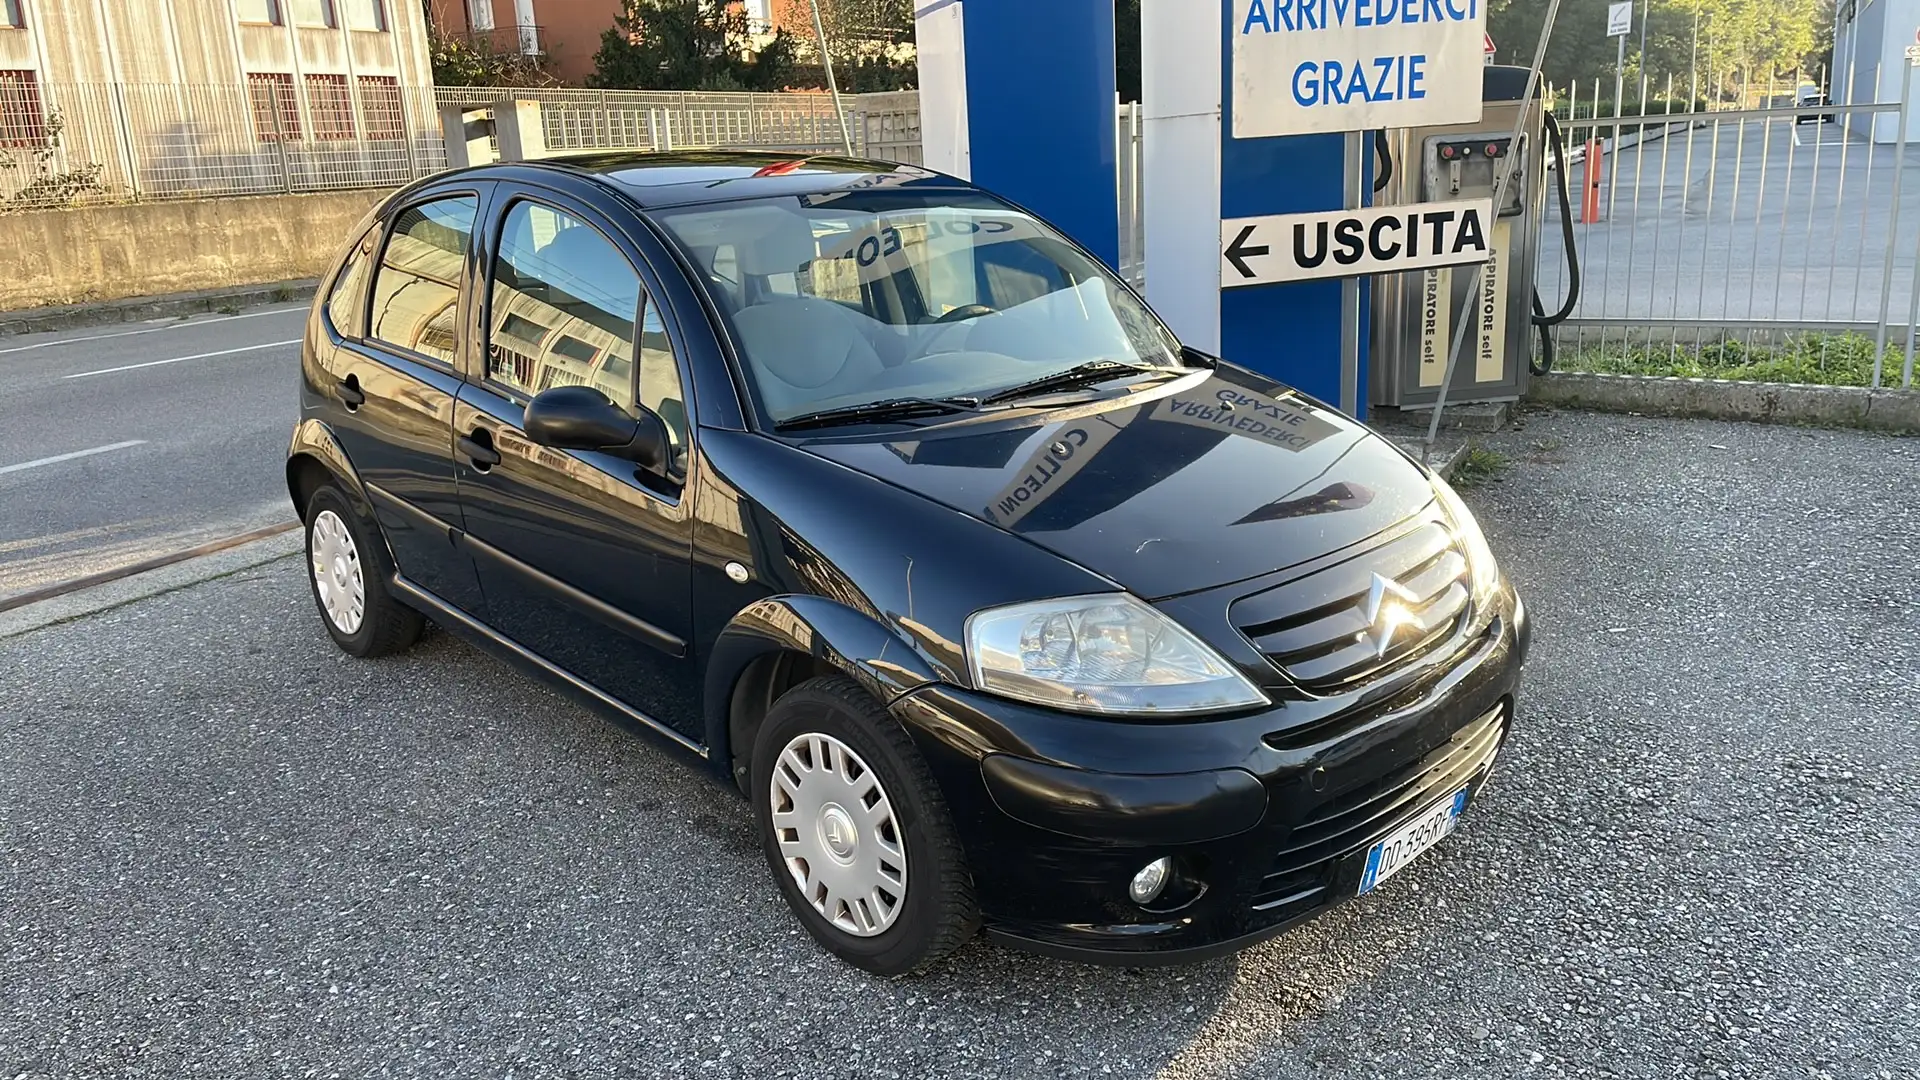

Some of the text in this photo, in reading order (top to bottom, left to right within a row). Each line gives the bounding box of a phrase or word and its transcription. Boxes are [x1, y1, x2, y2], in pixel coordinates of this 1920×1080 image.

[1292, 55, 1426, 107] GRAZIE
[1293, 209, 1487, 268] USCITA
[1424, 270, 1437, 363] PIRATORE self
[1482, 248, 1496, 359] ASPIRATORE self
